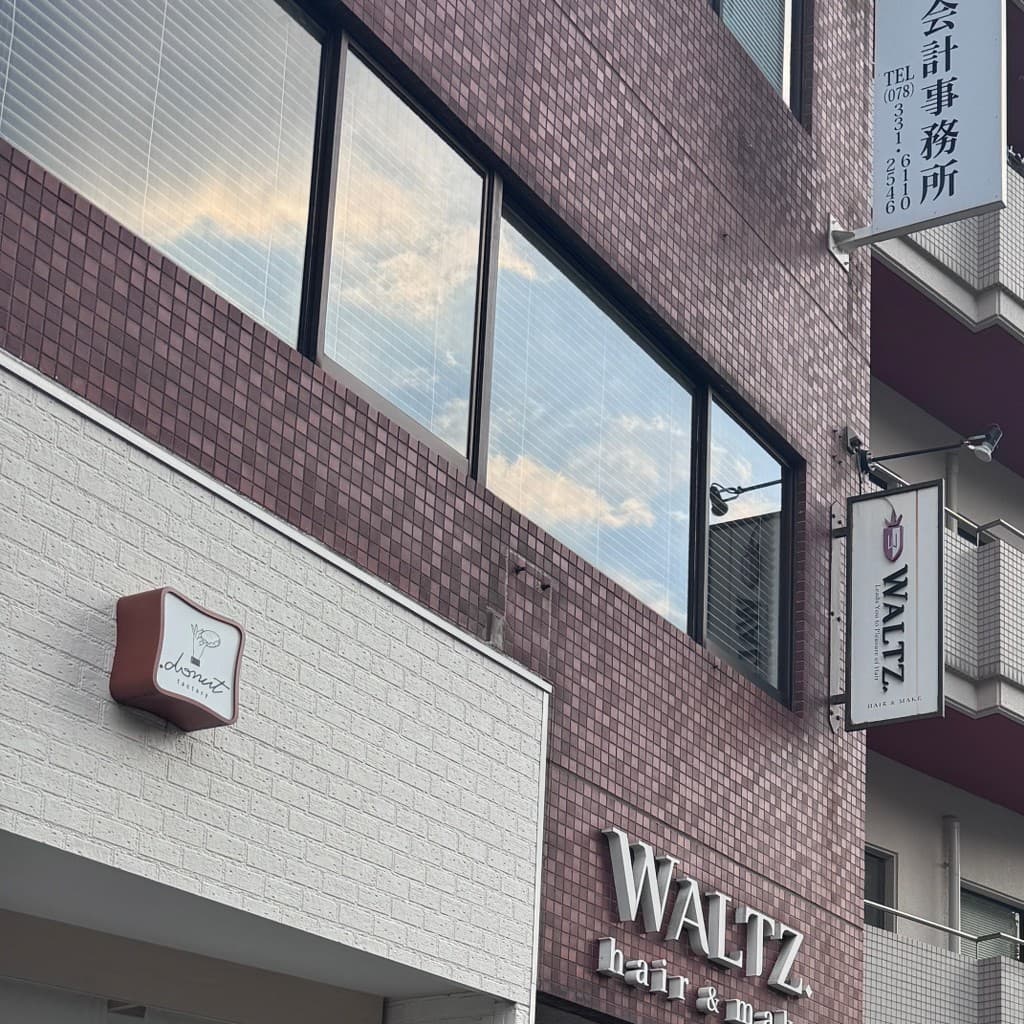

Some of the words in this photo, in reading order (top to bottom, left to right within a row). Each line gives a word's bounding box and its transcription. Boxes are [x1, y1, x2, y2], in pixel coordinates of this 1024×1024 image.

[884, 65, 914, 87] TEL
[884, 83, 914, 104] (078)
[920, 0, 959, 205] 会計事務所
[596, 936, 689, 1001] hair
[696, 986, 720, 1015] &
